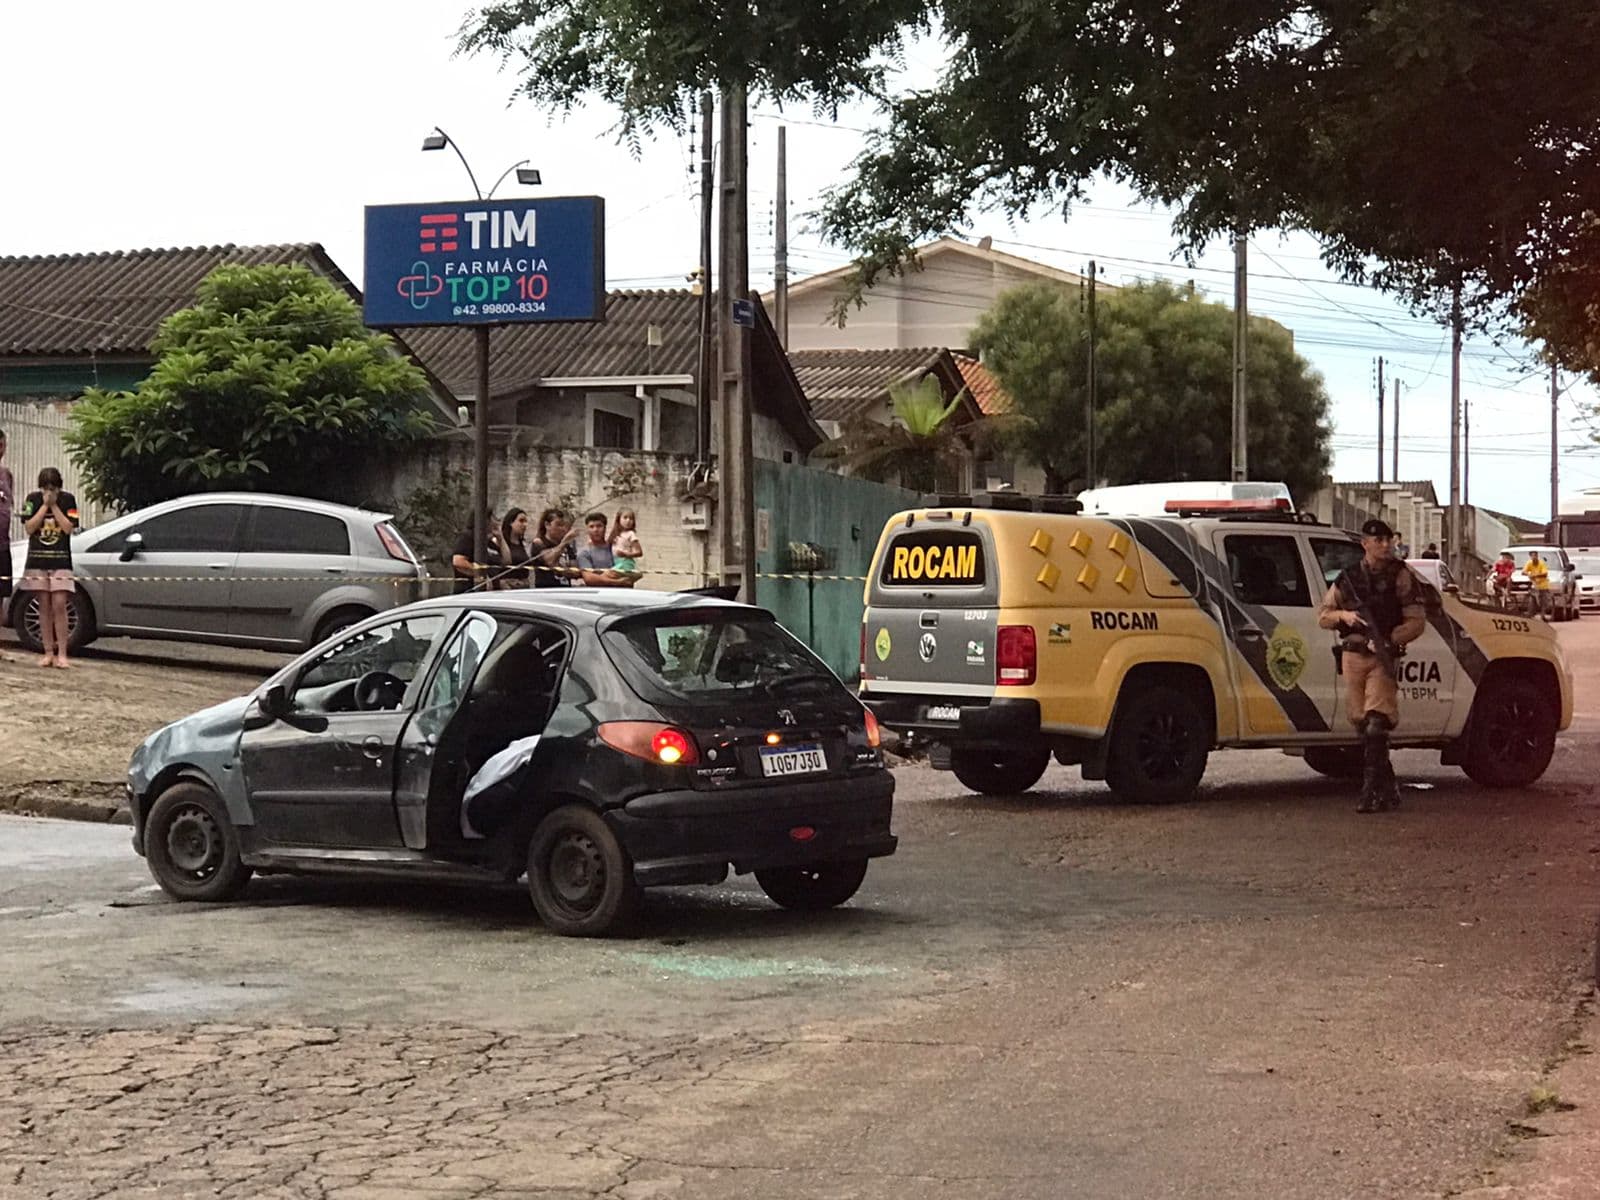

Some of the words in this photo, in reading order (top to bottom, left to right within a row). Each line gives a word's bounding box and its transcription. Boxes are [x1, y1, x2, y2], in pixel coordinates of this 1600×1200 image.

[464, 209, 536, 249] TIM
[445, 257, 548, 275] FARMÁCIA
[445, 276, 511, 303] TOP
[516, 274, 548, 300] 10
[482, 302, 546, 314] 99800-8334
[893, 545, 977, 579] ROCAM
[1090, 611, 1159, 630] ROCAM
[1491, 619, 1530, 632] 12703
